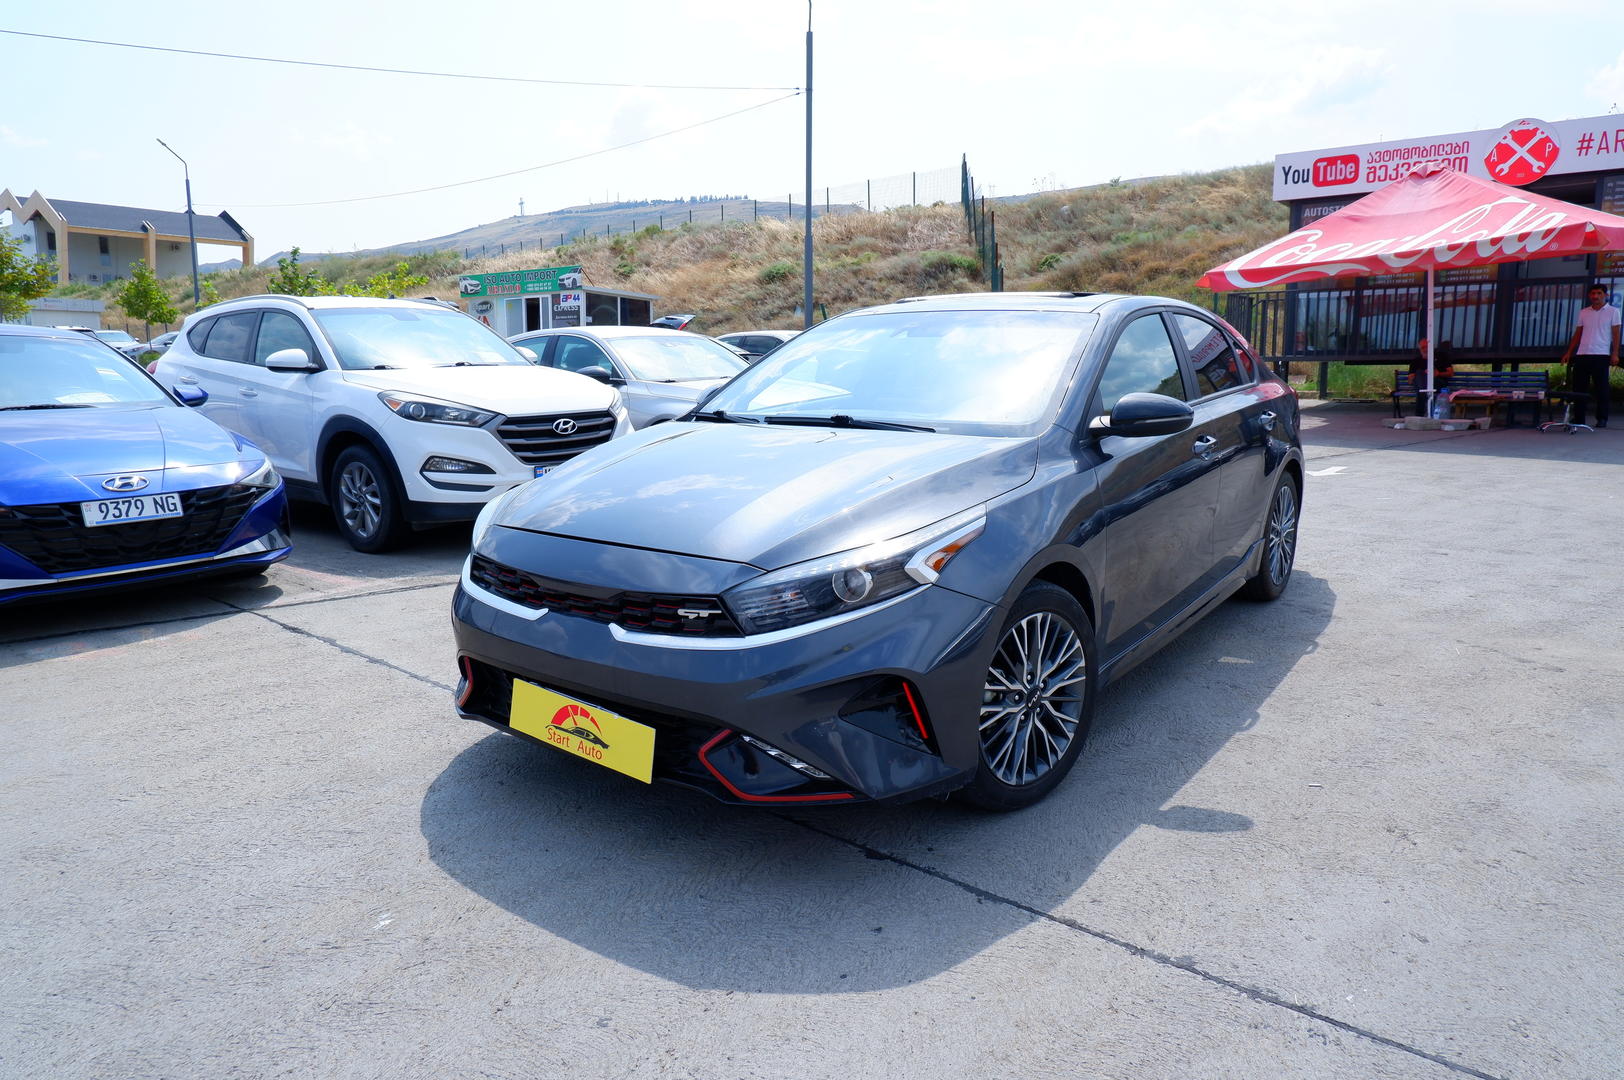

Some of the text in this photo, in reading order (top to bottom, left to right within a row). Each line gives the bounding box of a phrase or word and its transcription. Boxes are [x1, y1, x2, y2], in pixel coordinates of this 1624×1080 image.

[1366, 140, 1470, 165] ავტომობილები
[1304, 205, 1345, 217] AUTOST
[499, 273, 521, 284] AUTO
[524, 270, 557, 282] IMPORT
[98, 498, 145, 520] 9379
[152, 495, 178, 514] NG
[547, 727, 603, 760] Start Auto
